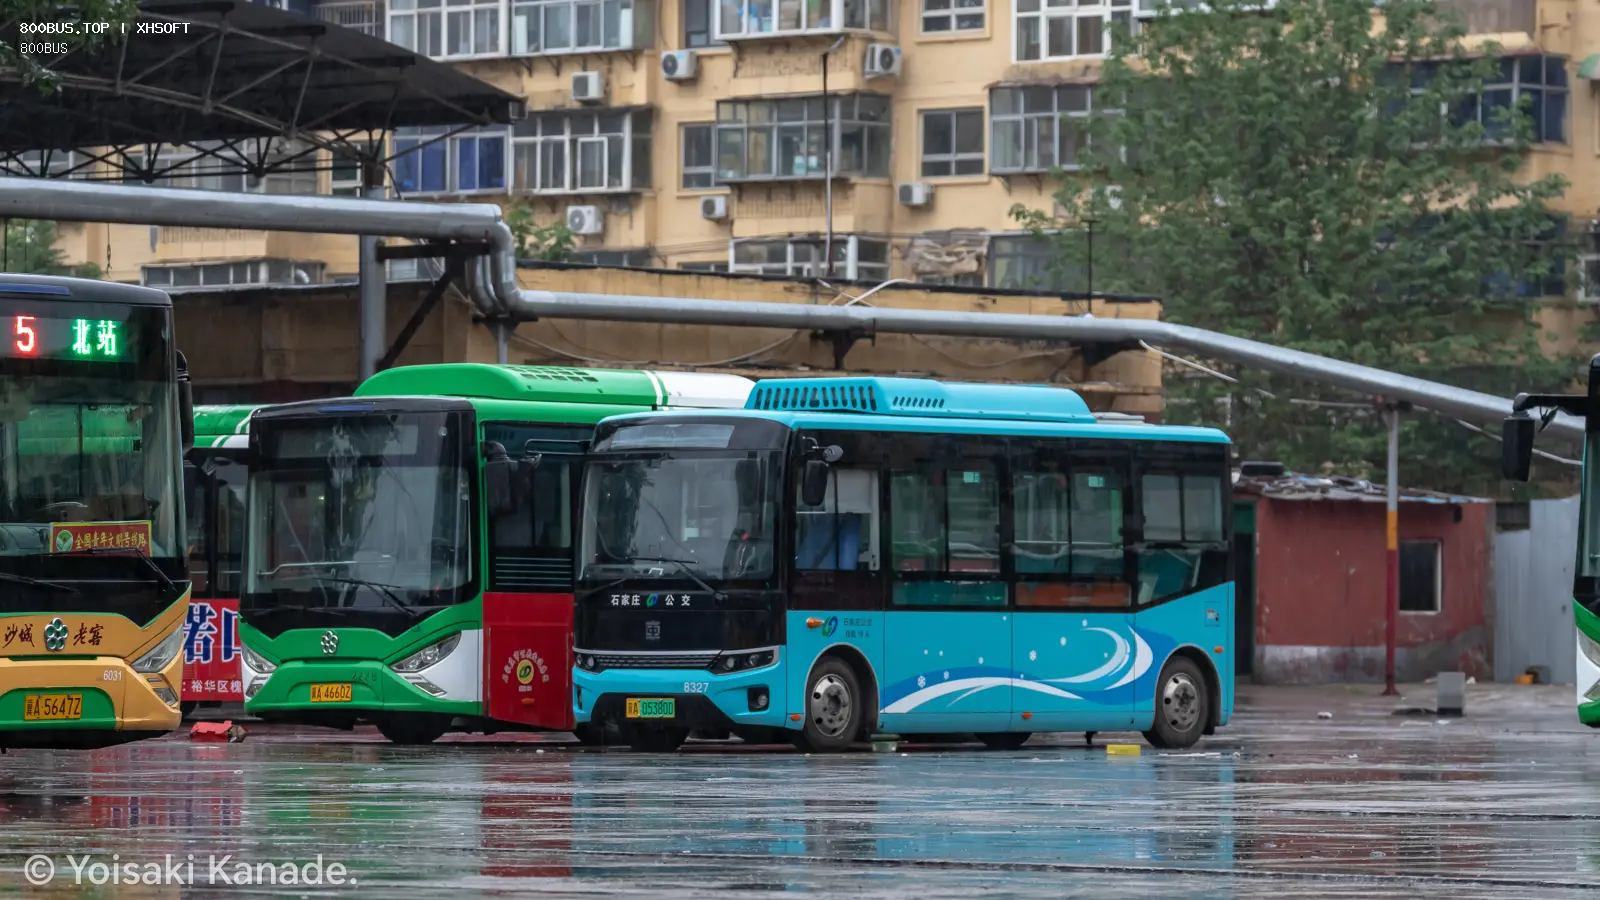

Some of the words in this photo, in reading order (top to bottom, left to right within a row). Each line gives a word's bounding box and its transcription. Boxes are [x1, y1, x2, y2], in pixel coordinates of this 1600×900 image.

[15, 315, 36, 352] 5
[72, 318, 118, 356] 北站
[75, 531, 147, 549] 全国青年文明号线路
[610, 594, 641, 606] 石家庄
[665, 594, 691, 606] 公交
[2, 622, 36, 649] 沙城
[72, 622, 105, 647] 老窖
[103, 669, 122, 681] 6031
[683, 681, 709, 693] 8327
